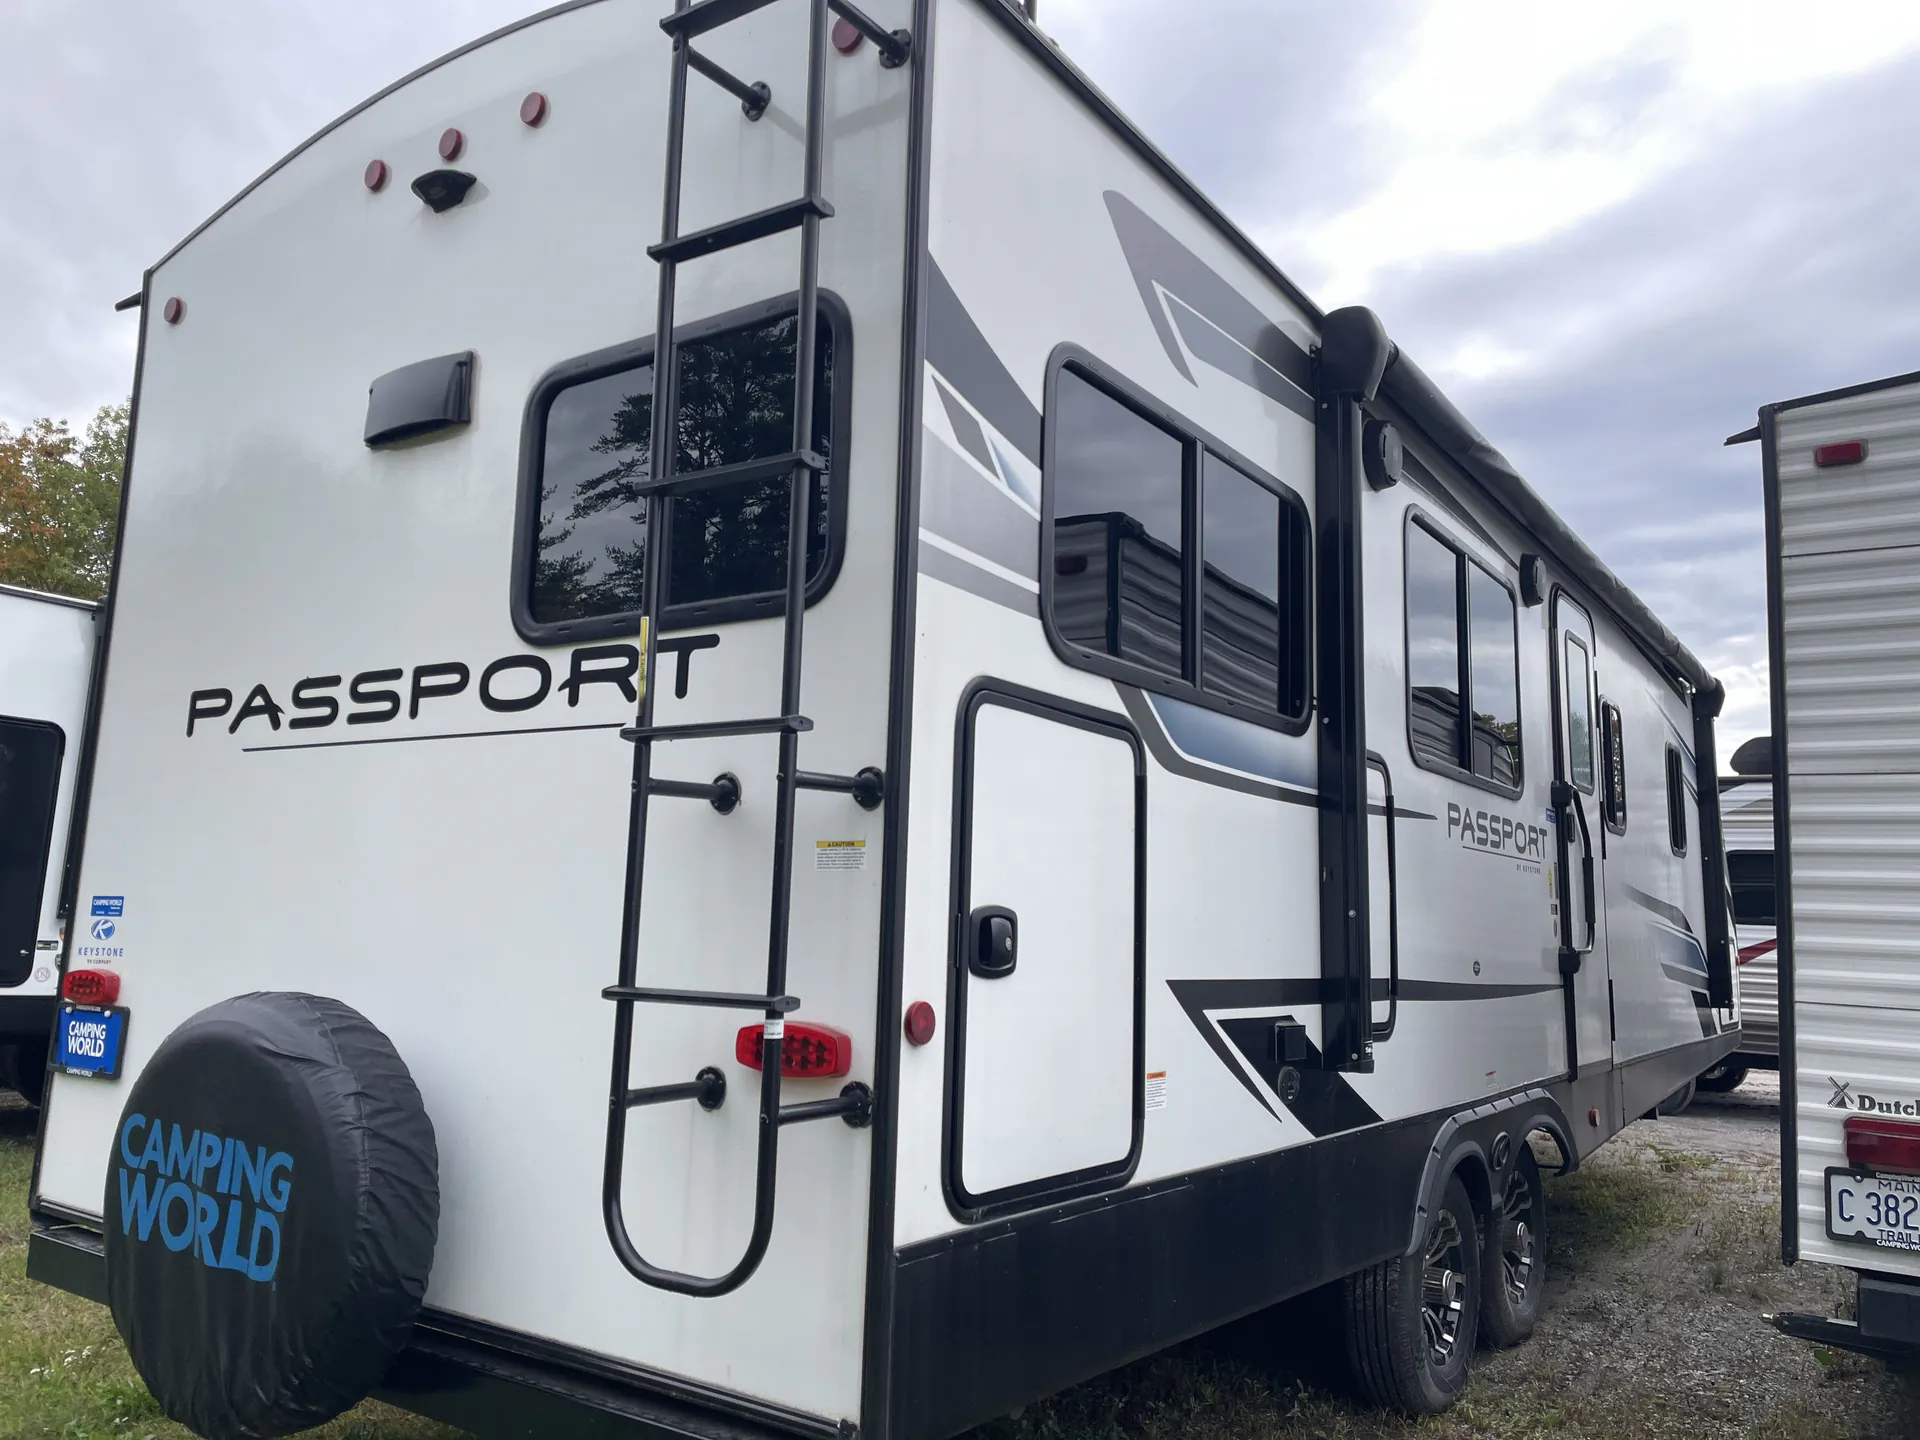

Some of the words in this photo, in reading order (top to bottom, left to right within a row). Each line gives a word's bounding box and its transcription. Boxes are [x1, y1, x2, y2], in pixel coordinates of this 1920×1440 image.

[186, 633, 720, 737] PASSPORT
[1447, 802, 1548, 859] PASSPORT
[78, 947, 124, 957] KEYSTONE
[68, 1020, 106, 1040] CAMPING
[68, 1035, 104, 1057] WORLD
[66, 1067, 81, 1076] CAMPING
[81, 1069, 93, 1077] WORLD
[120, 1113, 294, 1213] CAMPING
[1838, 1188, 1855, 1222] C
[1865, 1191, 1919, 1231] 382
[118, 1167, 281, 1283] WORLD
[1876, 1239, 1910, 1250] CAMPING
[1877, 1228, 1920, 1245] TRAIL
